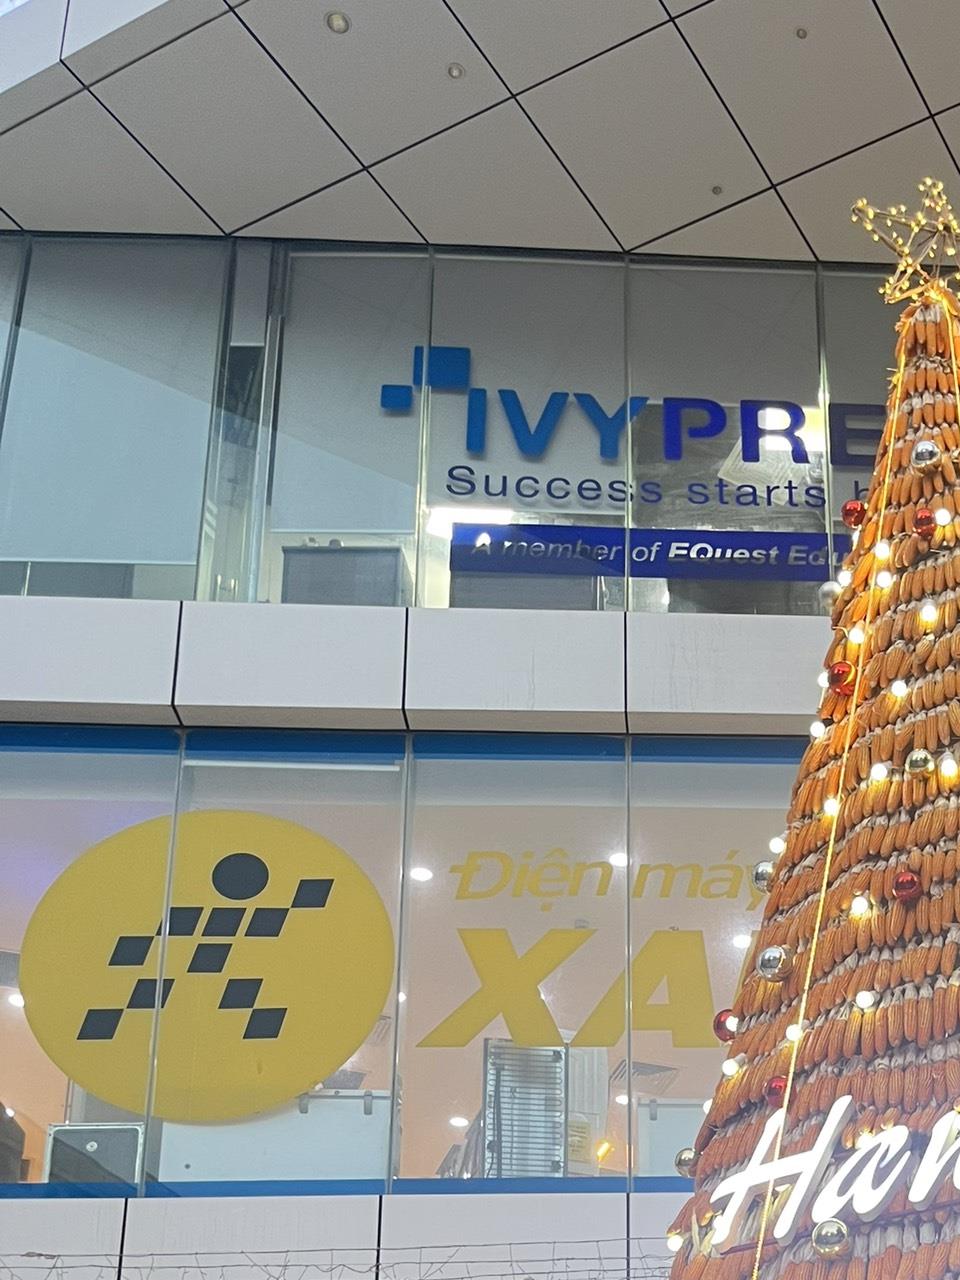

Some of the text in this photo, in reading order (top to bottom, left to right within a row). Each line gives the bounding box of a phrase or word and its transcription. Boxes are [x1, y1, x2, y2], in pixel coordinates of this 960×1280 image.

[445, 465, 663, 503] Success
[687, 478, 826, 508] starts
[503, 539, 623, 563] member
[632, 541, 662, 564] of
[668, 541, 779, 567] EQuest
[449, 849, 613, 912] Điện
[415, 928, 757, 1049] XA
